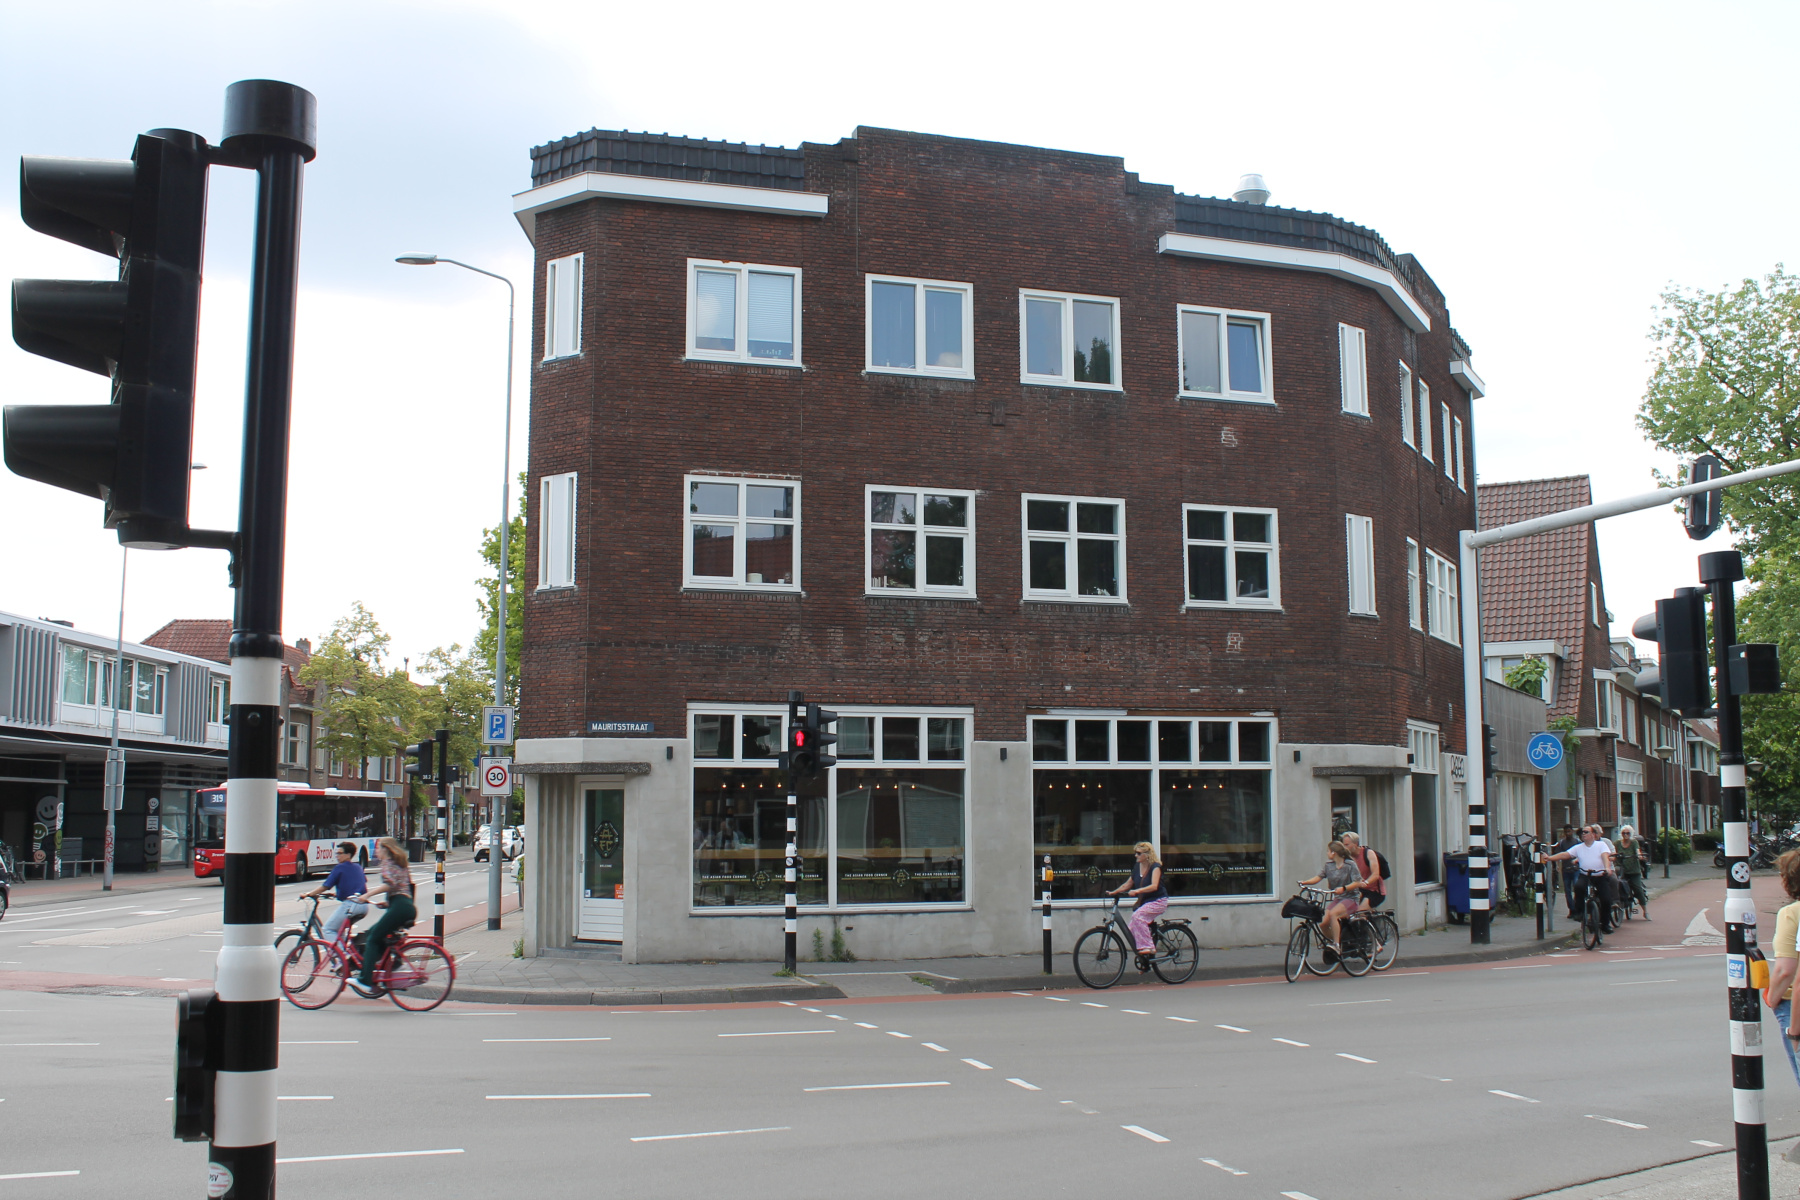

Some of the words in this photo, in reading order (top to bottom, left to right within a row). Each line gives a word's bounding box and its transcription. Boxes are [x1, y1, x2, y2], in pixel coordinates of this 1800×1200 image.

[493, 716, 502, 728] P
[592, 723, 648, 731] MAURITSSTRAAT
[490, 772, 503, 781] 30
[211, 794, 224, 803] 319
[316, 846, 332, 859] Bravo
